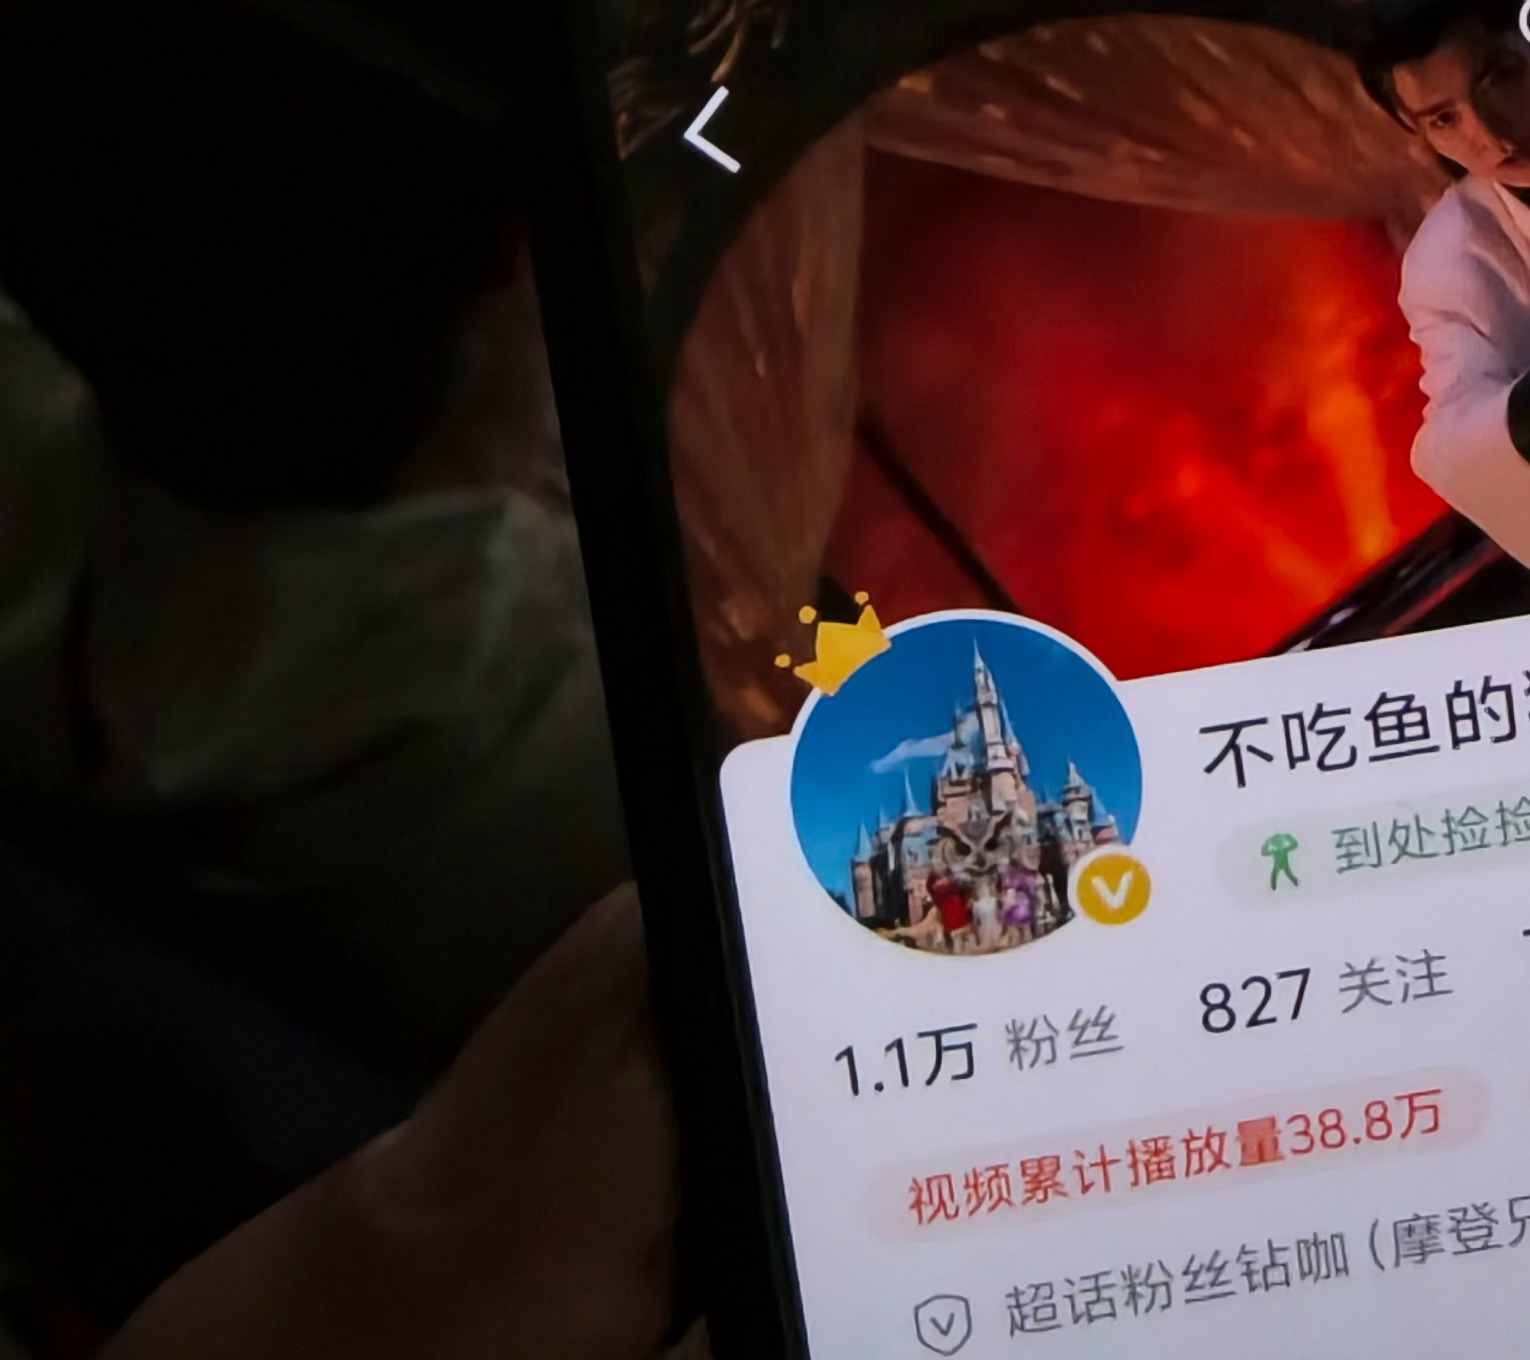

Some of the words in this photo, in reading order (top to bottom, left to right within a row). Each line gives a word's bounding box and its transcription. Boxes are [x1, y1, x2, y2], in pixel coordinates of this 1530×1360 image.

[835, 1023, 978, 1098] 1.1万
[1005, 1005, 1125, 1073] 粉丝
[1200, 968, 1312, 1035] 827
[1339, 949, 1455, 1015] 关注
[908, 1088, 1443, 1225] 视频累计播放量38.8万
